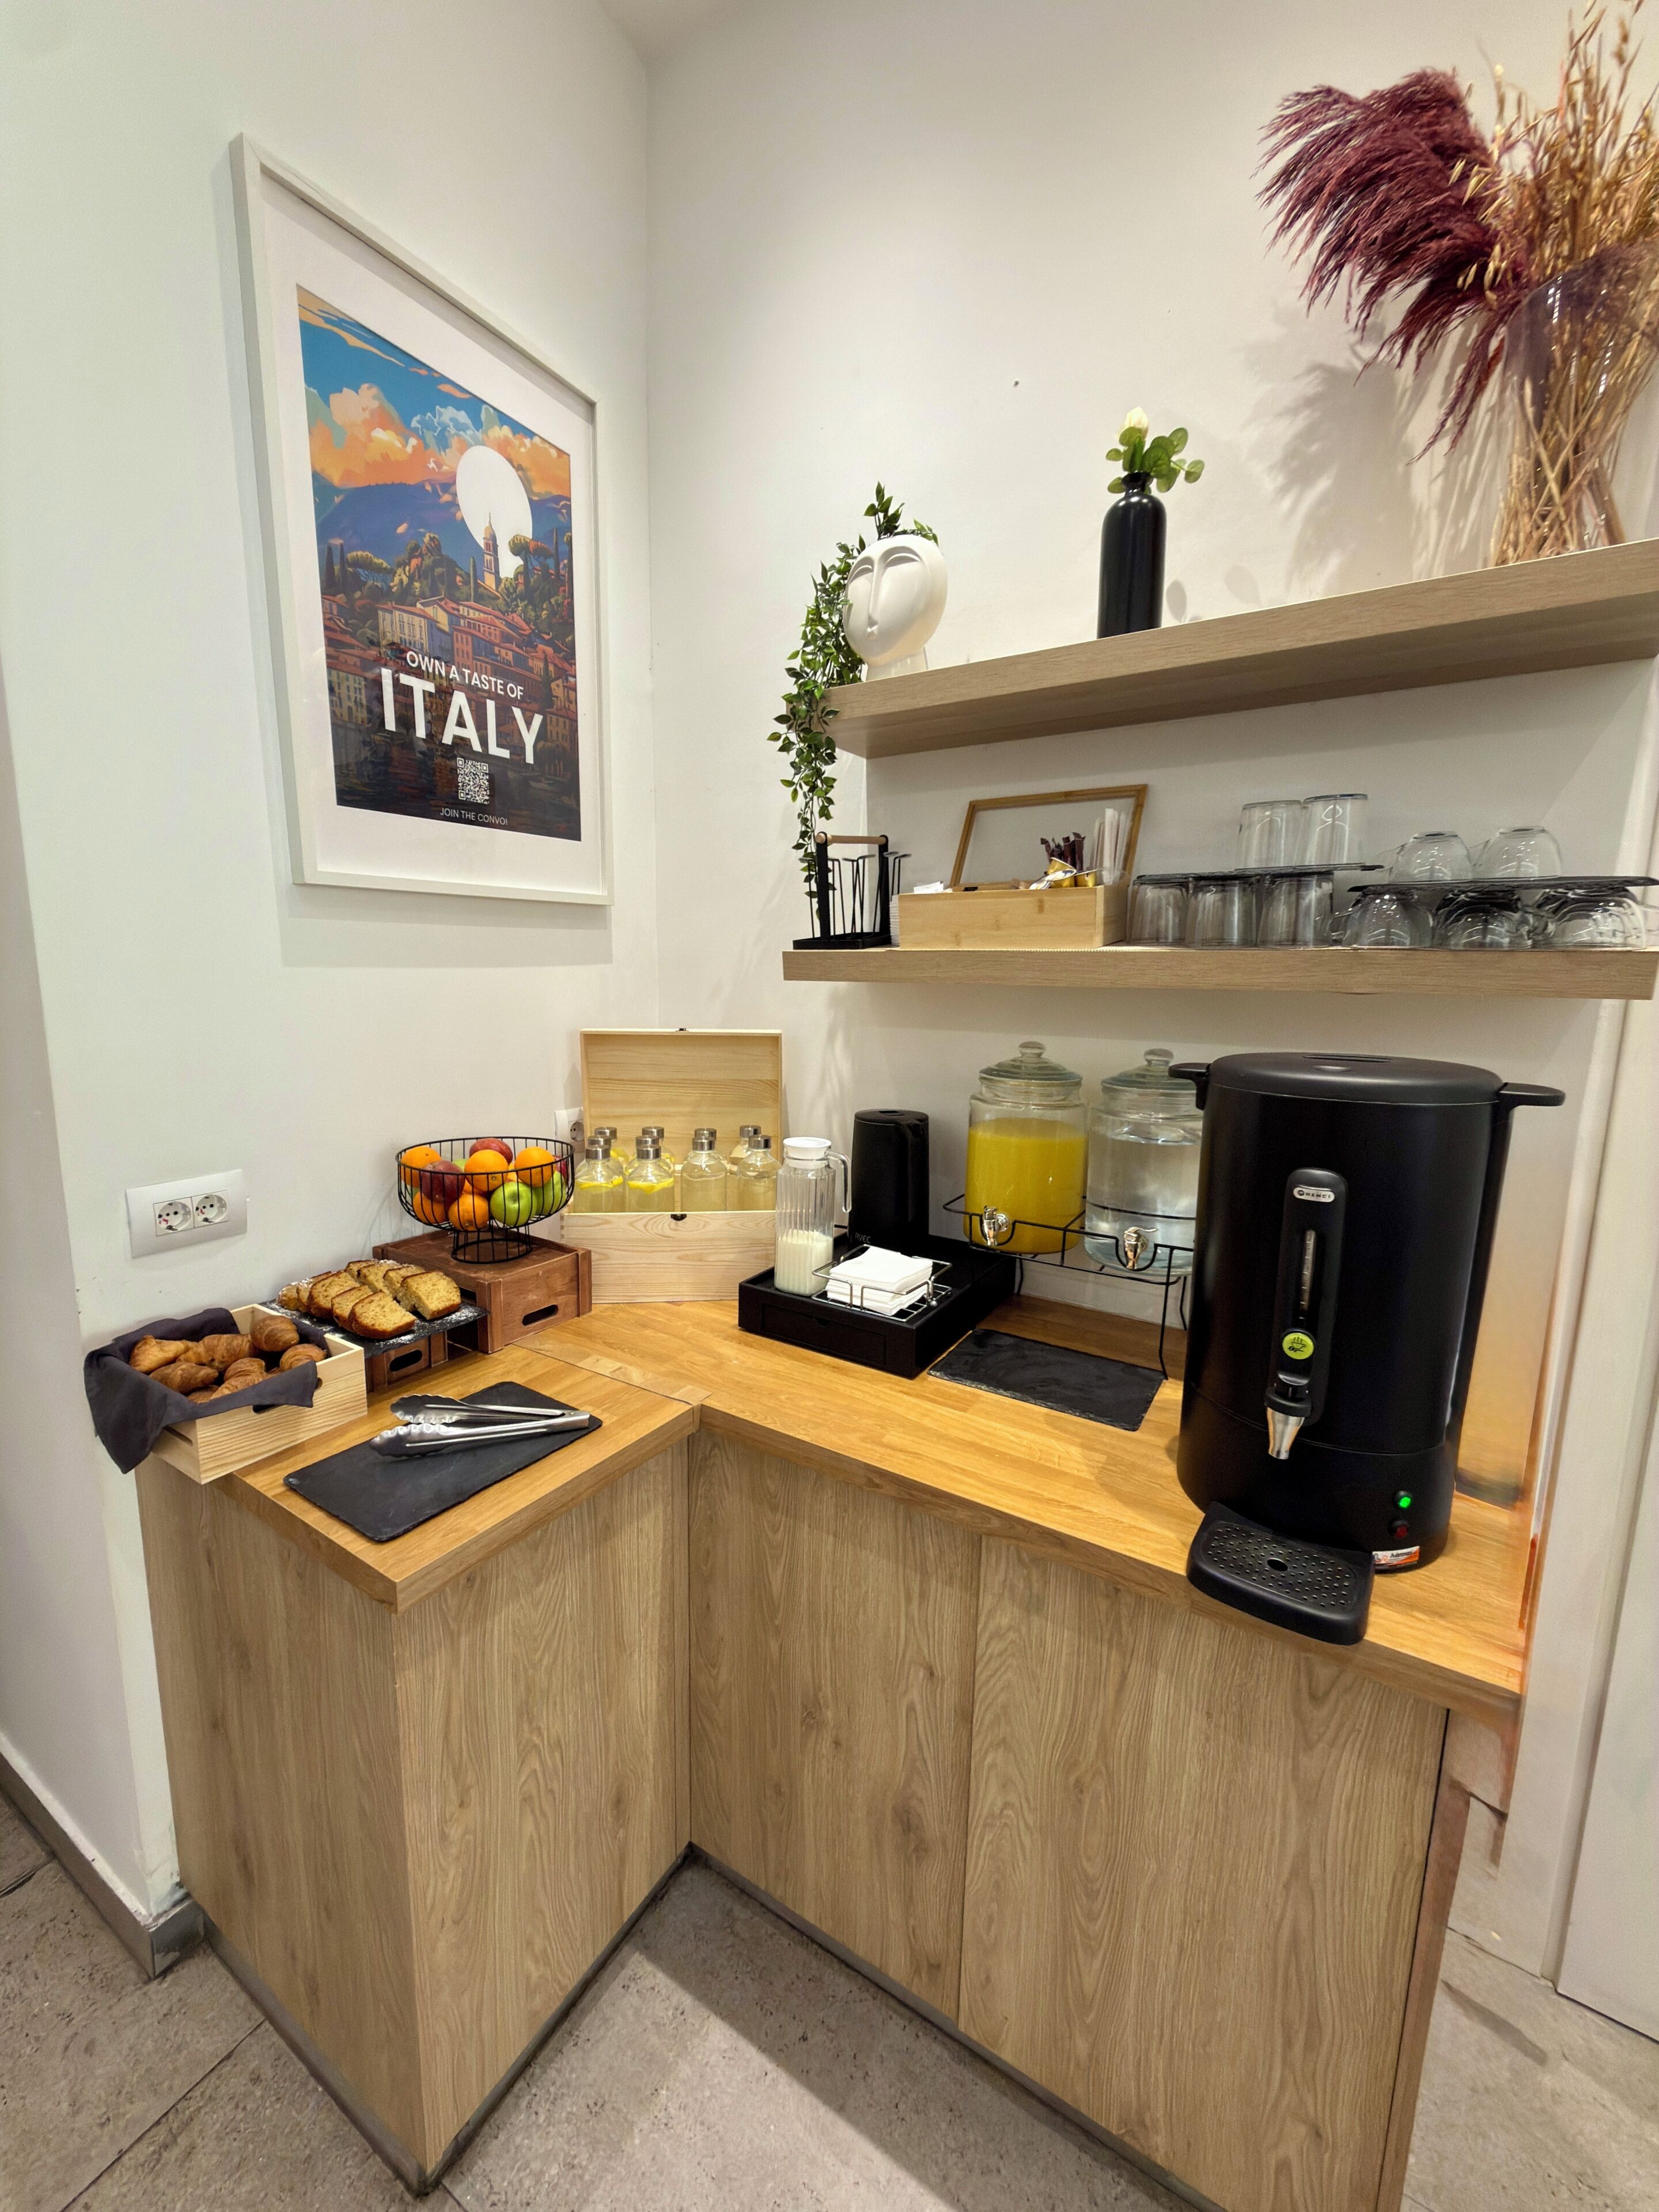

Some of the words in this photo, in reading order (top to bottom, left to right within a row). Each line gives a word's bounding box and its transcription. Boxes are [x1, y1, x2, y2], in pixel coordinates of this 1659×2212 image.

[406, 651, 446, 677] OWN
[449, 665, 460, 681] A
[462, 668, 504, 695] TASTE
[507, 683, 524, 700] OF
[381, 667, 543, 764] ITALY
[440, 807, 459, 818] JOIN
[461, 810, 476, 821] THE
